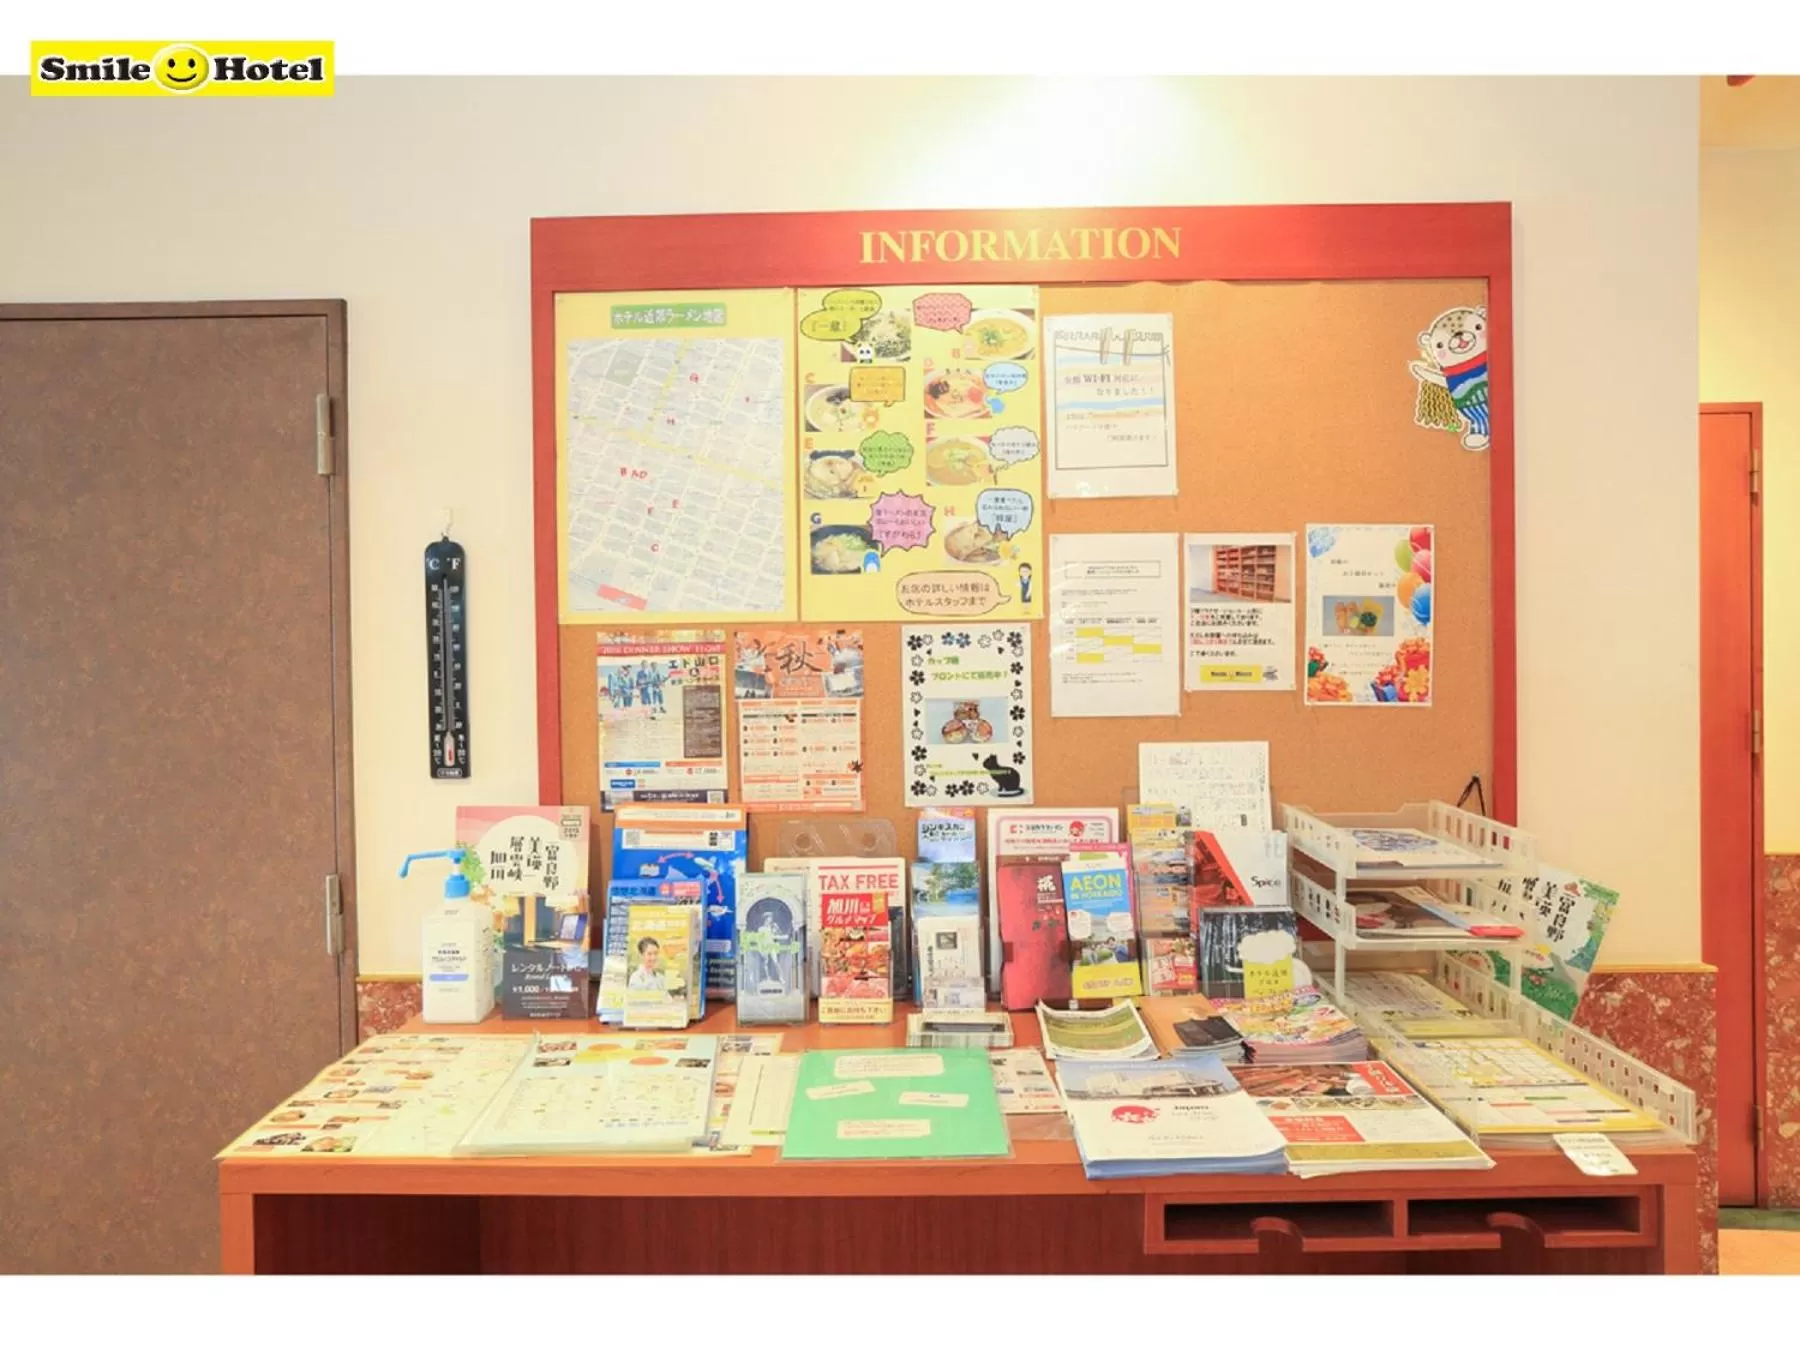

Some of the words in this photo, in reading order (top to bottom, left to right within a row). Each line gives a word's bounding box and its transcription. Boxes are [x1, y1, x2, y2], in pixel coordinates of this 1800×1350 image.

[859, 226, 1182, 264] INFORMATION
[905, 596, 986, 607] ホテルスタッフまで
[775, 640, 824, 674] 秋
[818, 874, 851, 890] TAX
[856, 873, 899, 889] FREE
[1071, 873, 1121, 892] AEON
[1251, 875, 1281, 888] Spice
[827, 898, 860, 914] 旭川
